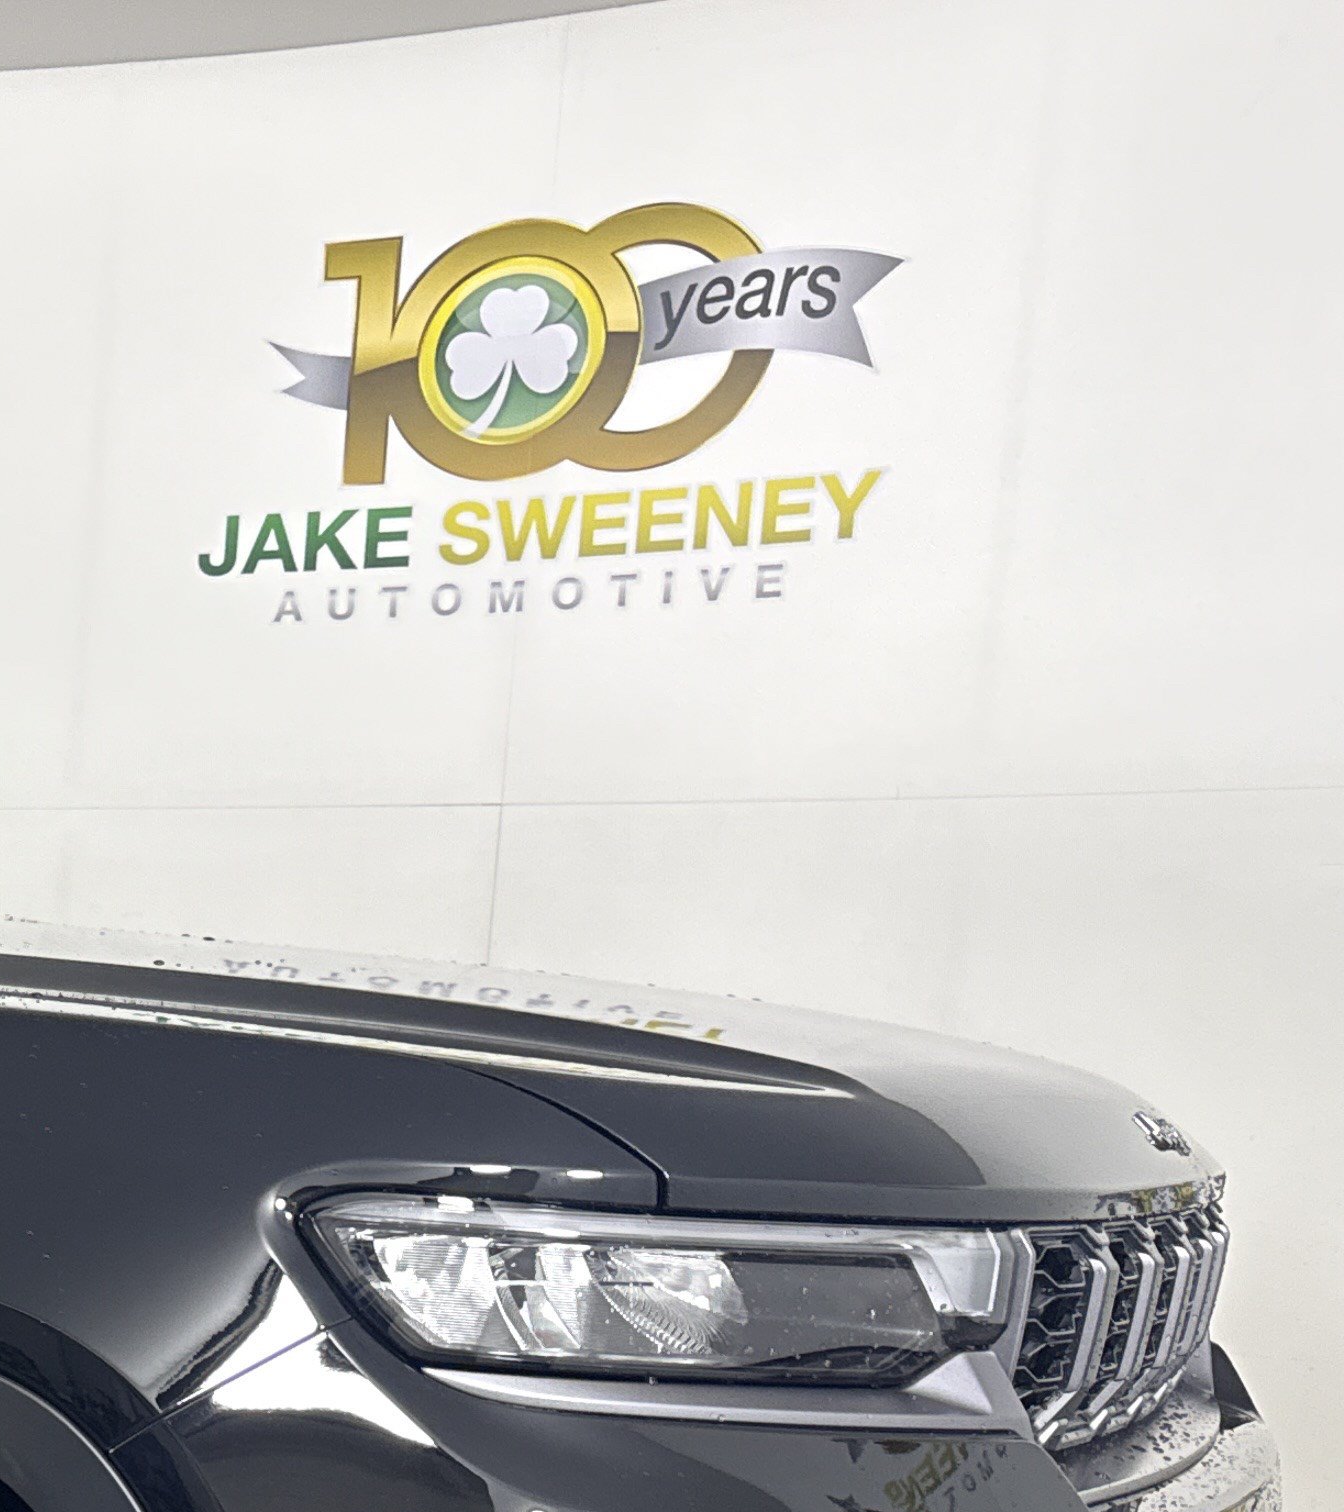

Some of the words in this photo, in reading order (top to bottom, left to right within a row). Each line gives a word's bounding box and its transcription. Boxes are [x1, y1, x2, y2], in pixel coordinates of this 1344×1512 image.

[653, 259, 842, 350] years
[198, 505, 413, 577] JAKE
[439, 469, 883, 566] SWEENEY
[273, 562, 787, 623] AUTOMOTIVE
